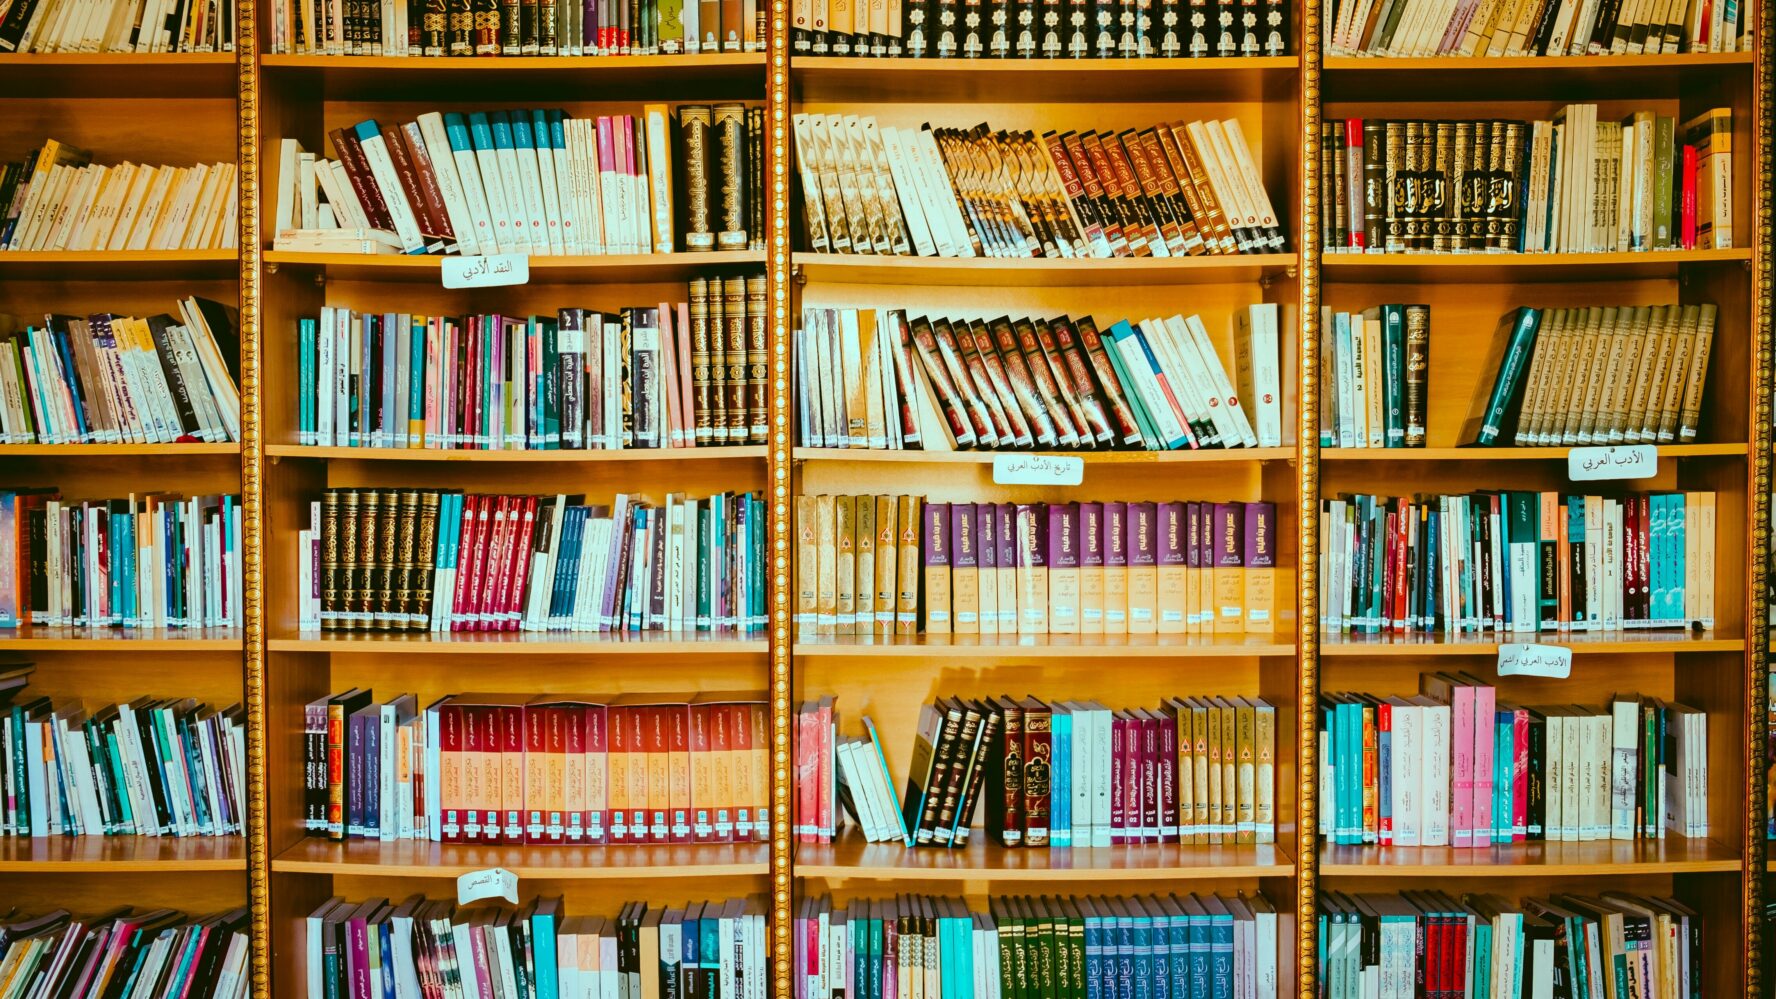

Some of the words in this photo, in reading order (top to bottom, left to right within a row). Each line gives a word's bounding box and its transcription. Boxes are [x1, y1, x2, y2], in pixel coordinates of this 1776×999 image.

[462, 259, 490, 281] الأدبي
[493, 259, 513, 274] النقد
[565, 332, 573, 351] شرح
[640, 330, 649, 348] شرح
[562, 354, 574, 369] ألفية
[638, 351, 650, 367] ألفية
[170, 366, 185, 389] الأعمال
[564, 368, 574, 381] ابن
[640, 366, 650, 379] ابن
[176, 385, 191, 405] الكاملة
[563, 381, 575, 403] معطي
[639, 378, 652, 402] معطي
[1007, 459, 1028, 472] العربي
[1030, 459, 1052, 472] الأدب
[1582, 452, 1611, 472] العربي
[1614, 449, 1644, 467] الأدب
[1054, 461, 1071, 476] تاريخ
[933, 512, 942, 526] عمر
[961, 513, 971, 527] عمر
[1520, 655, 1542, 667] العربي
[1544, 656, 1567, 667] الأدب
[1001, 948, 1011, 961] قرون
[1016, 948, 1025, 960] قرون
[1029, 949, 1038, 961] قرون
[1041, 946, 1050, 958] قرون
[1059, 947, 1068, 959] قرون
[1072, 948, 1081, 960] قرون
[1088, 959, 1102, 976] نفح
[1103, 959, 1118, 977] نفح
[1120, 959, 1134, 977] نفح
[1136, 959, 1150, 977] نفح
[1155, 959, 1169, 977] نفح
[1174, 957, 1188, 974] نفح
[1194, 956, 1208, 974] نفح
[1216, 956, 1230, 974] نفح
[666, 966, 676, 987] الأعمال
[1003, 969, 1013, 989] الأدب
[1017, 969, 1027, 989] الأدب
[1031, 969, 1039, 989] الأدب
[1042, 967, 1051, 987] الأدب
[1059, 967, 1069, 988] الأدب
[1073, 969, 1083, 989] الأدب
[1088, 976, 1101, 999] الطيب
[1104, 976, 1117, 999] الطيب
[1120, 976, 1132, 999] الطيب
[1136, 976, 1150, 999] الطيب
[1155, 976, 1168, 999] الطيب
[1174, 974, 1187, 999] الطيب
[1193, 974, 1205, 998] الطيب
[1215, 973, 1229, 999] الطيب
